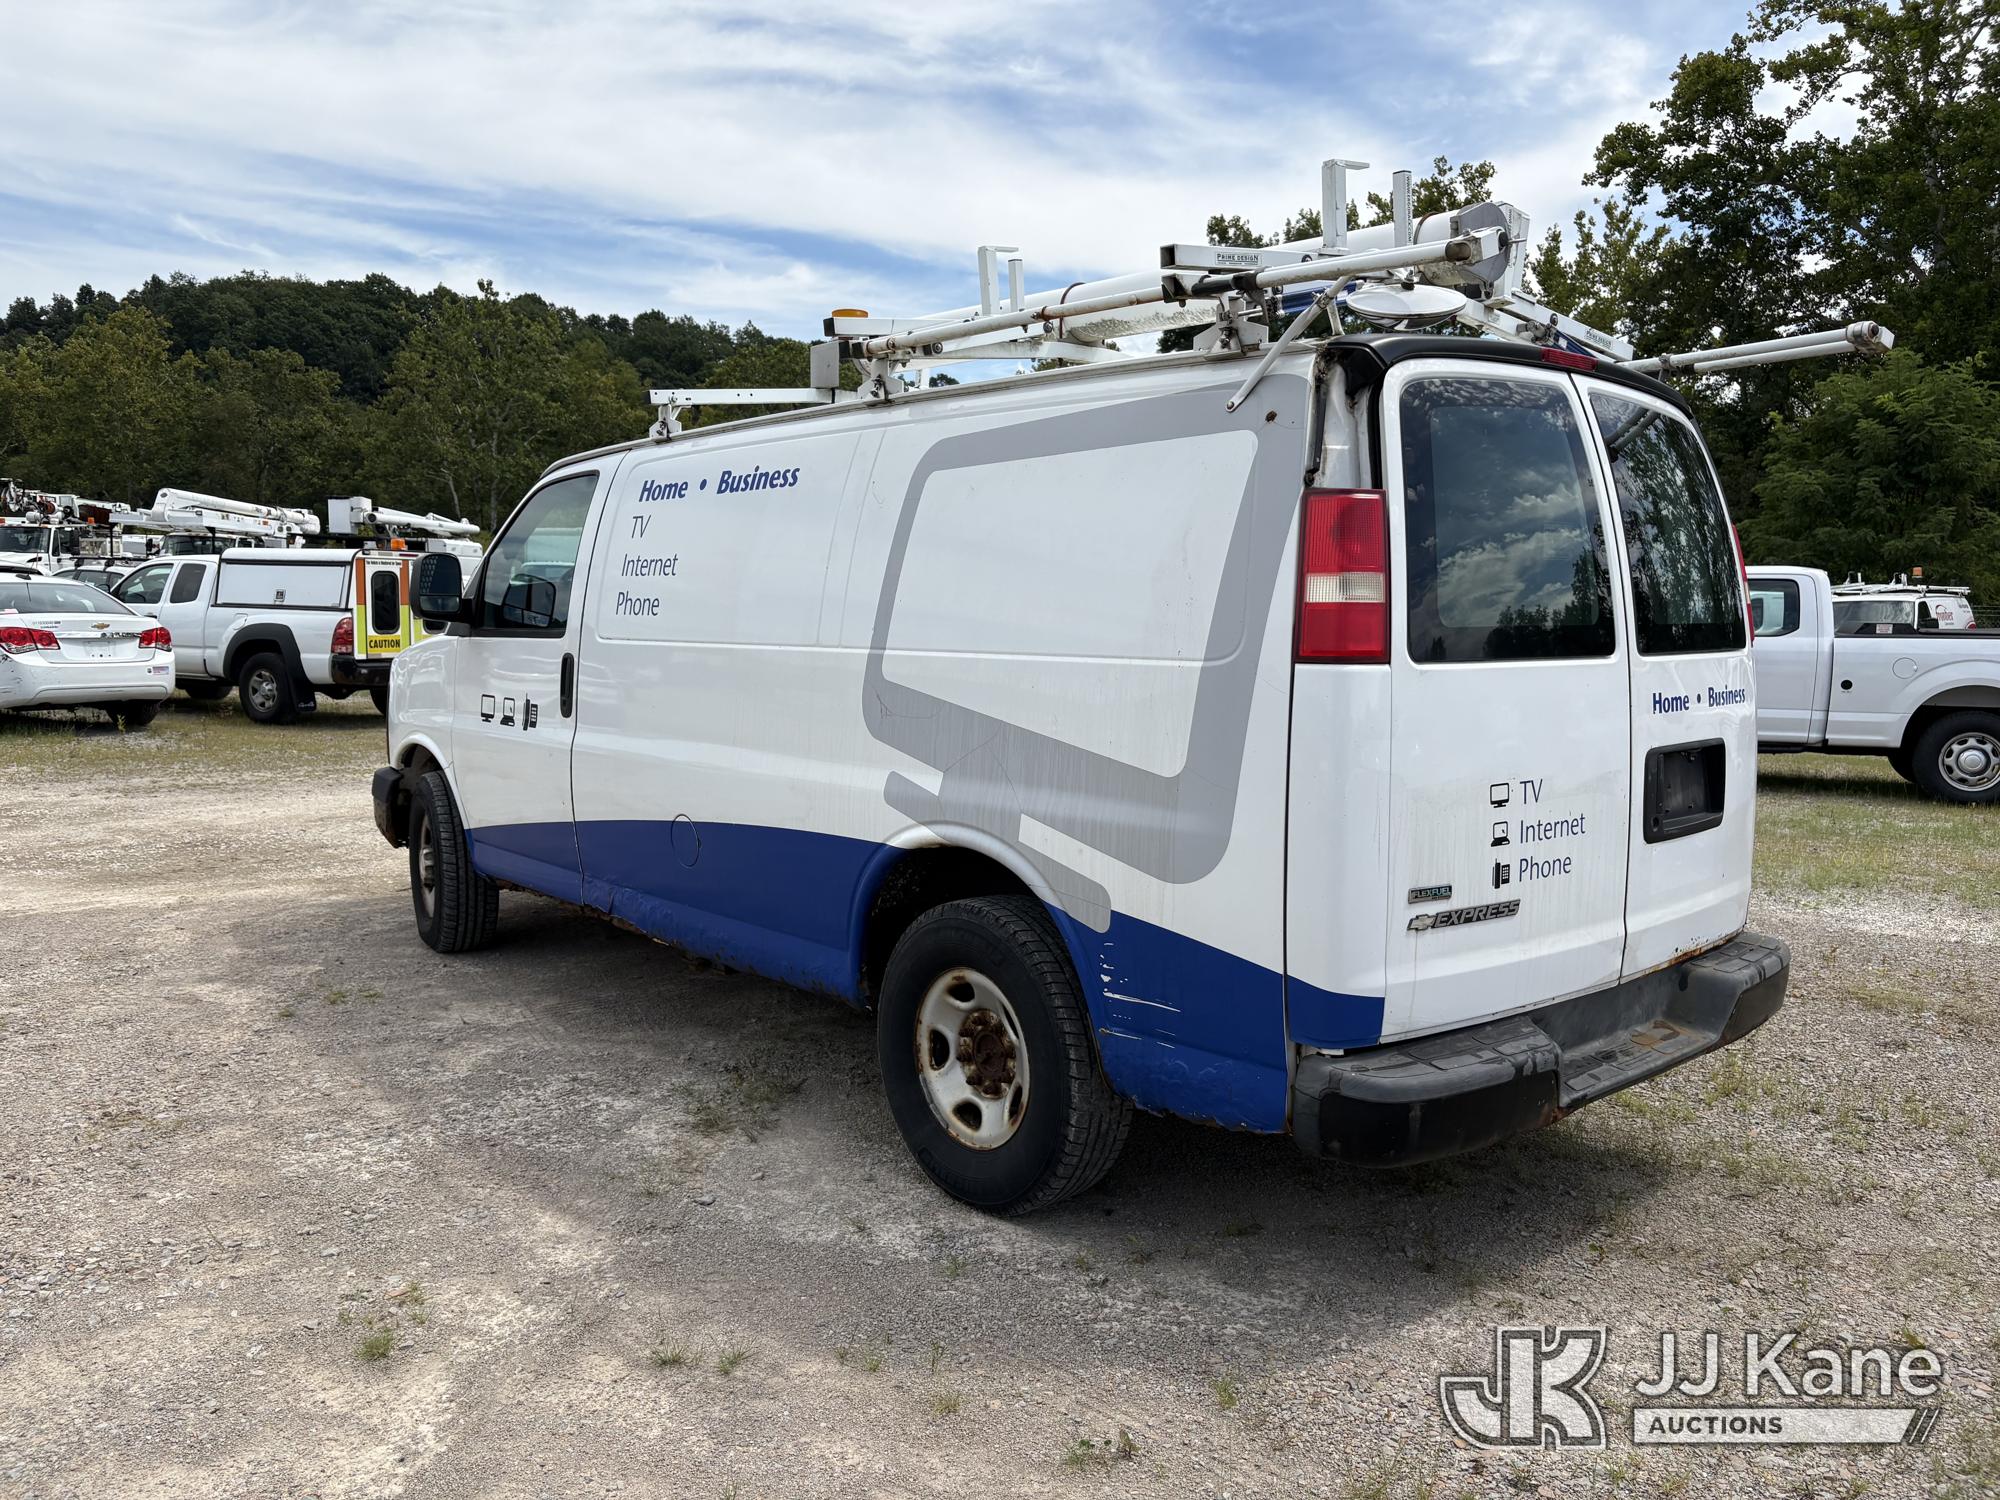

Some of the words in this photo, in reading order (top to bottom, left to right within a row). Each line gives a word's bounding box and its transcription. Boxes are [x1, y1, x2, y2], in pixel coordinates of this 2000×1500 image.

[639, 479, 688, 502] Home
[717, 465, 800, 494] Business
[632, 515, 651, 538] TV
[622, 554, 678, 577] Internet
[616, 590, 660, 616] Phone
[369, 639, 400, 648] CAUTION
[1653, 692, 1690, 714] Home
[1708, 686, 1746, 708] Business
[1519, 779, 1543, 804] TV
[1519, 813, 1586, 844] Internet
[1519, 855, 1572, 882] Phone
[1435, 902, 1520, 927] EXPRESS
